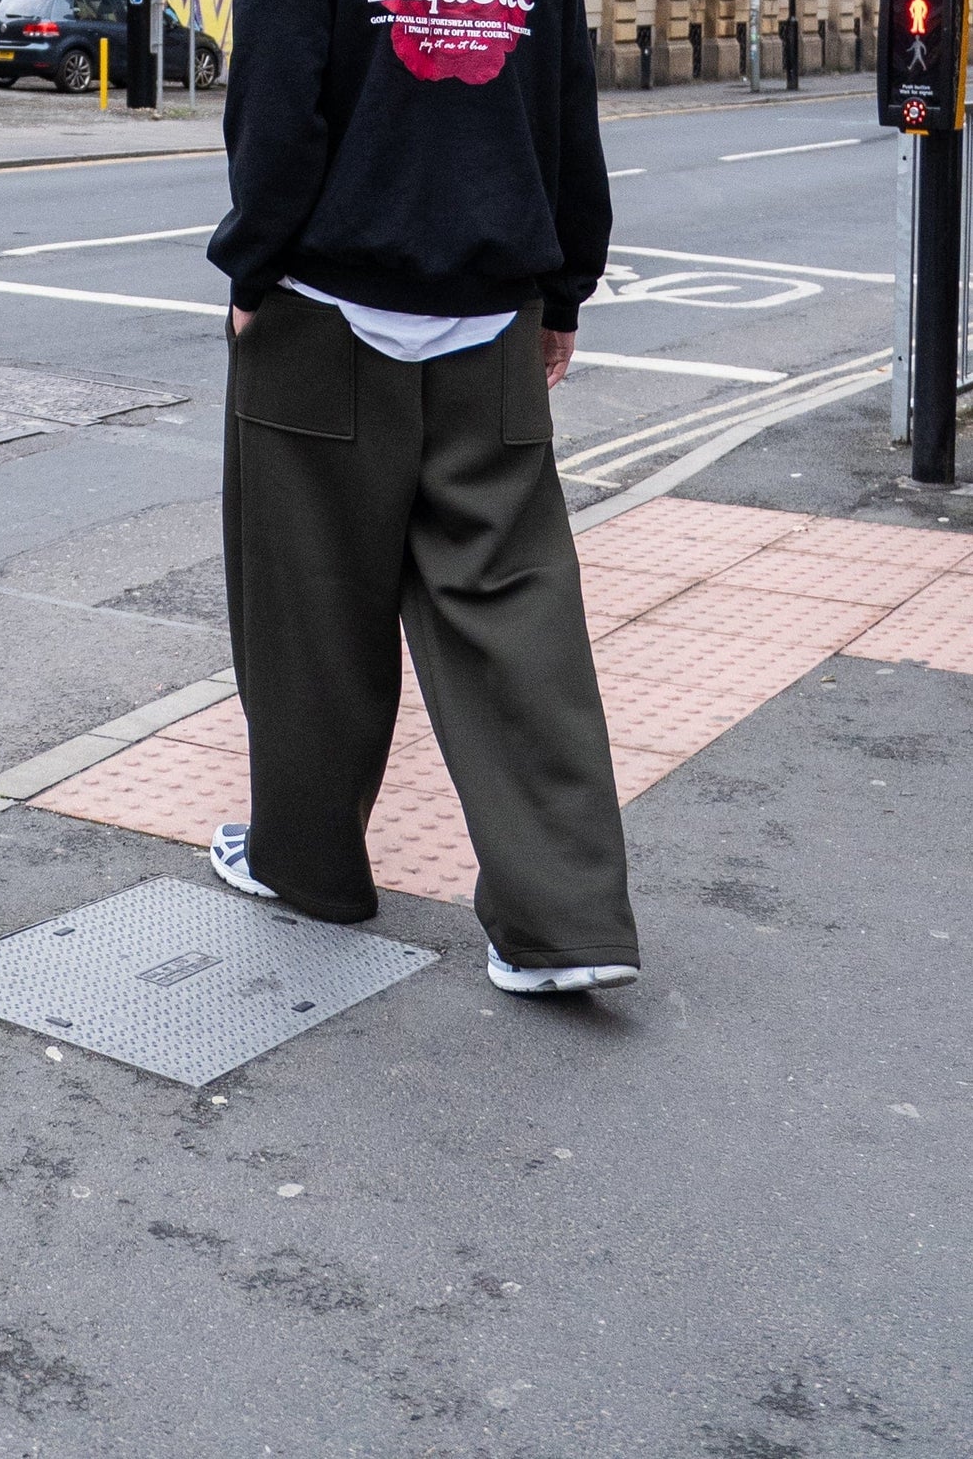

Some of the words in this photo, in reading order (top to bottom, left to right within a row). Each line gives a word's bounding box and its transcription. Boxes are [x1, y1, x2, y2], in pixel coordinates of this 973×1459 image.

[370, 15, 387, 25] GOLF
[387, 14, 395, 23] &
[395, 15, 415, 24] SOCIAL
[416, 16, 428, 25] CLUB
[430, 18, 473, 28] SPORTSWEAR
[474, 20, 502, 28] GOODS
[443, 28, 451, 36] &
[451, 29, 465, 37] OFF
[466, 29, 481, 37] THE
[482, 30, 510, 39] COURSE
[457, 39, 469, 50] it
[469, 40, 488, 51] lies
